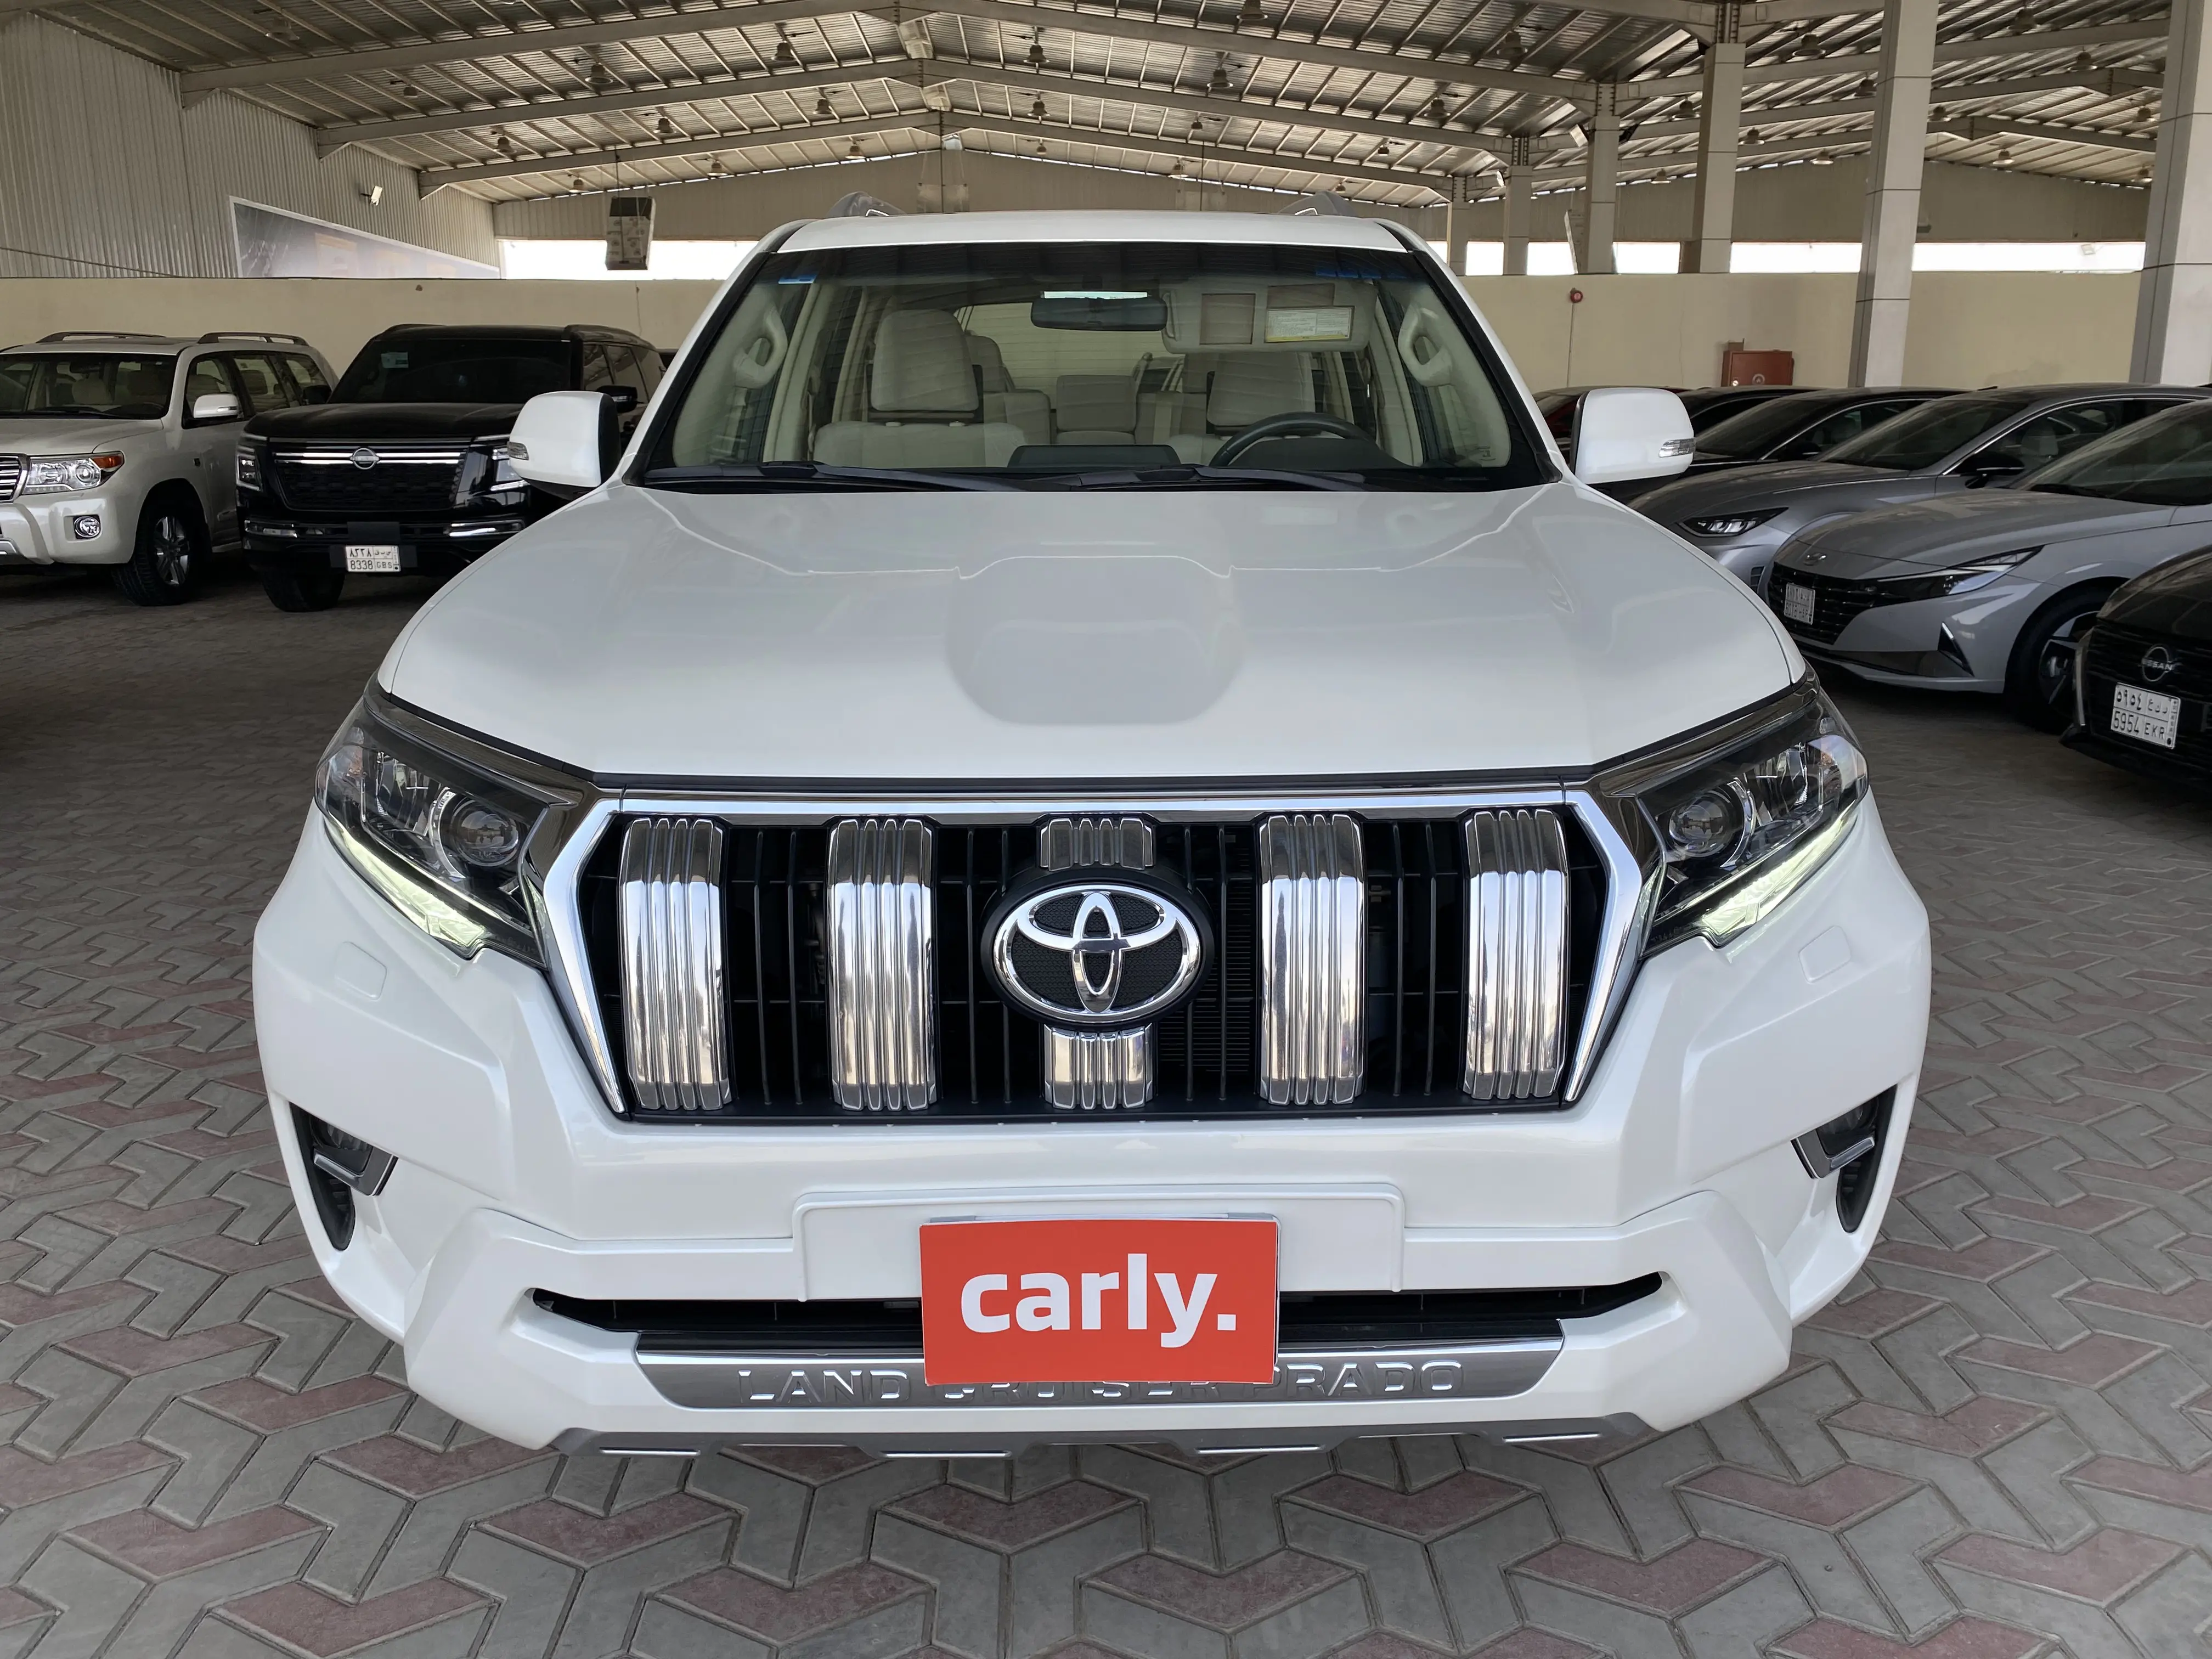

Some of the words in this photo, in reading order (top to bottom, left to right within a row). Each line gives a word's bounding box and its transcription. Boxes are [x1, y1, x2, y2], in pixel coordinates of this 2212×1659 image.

[350, 560, 373, 569] 8338
[2142, 658, 2174, 671] SSAN
[2113, 710, 2140, 735] 5954
[2144, 723, 2165, 740] EKR
[961, 1253, 1236, 1348] carly.
[738, 1369, 911, 1403] LAND
[1251, 1360, 1463, 1398] PRADO
